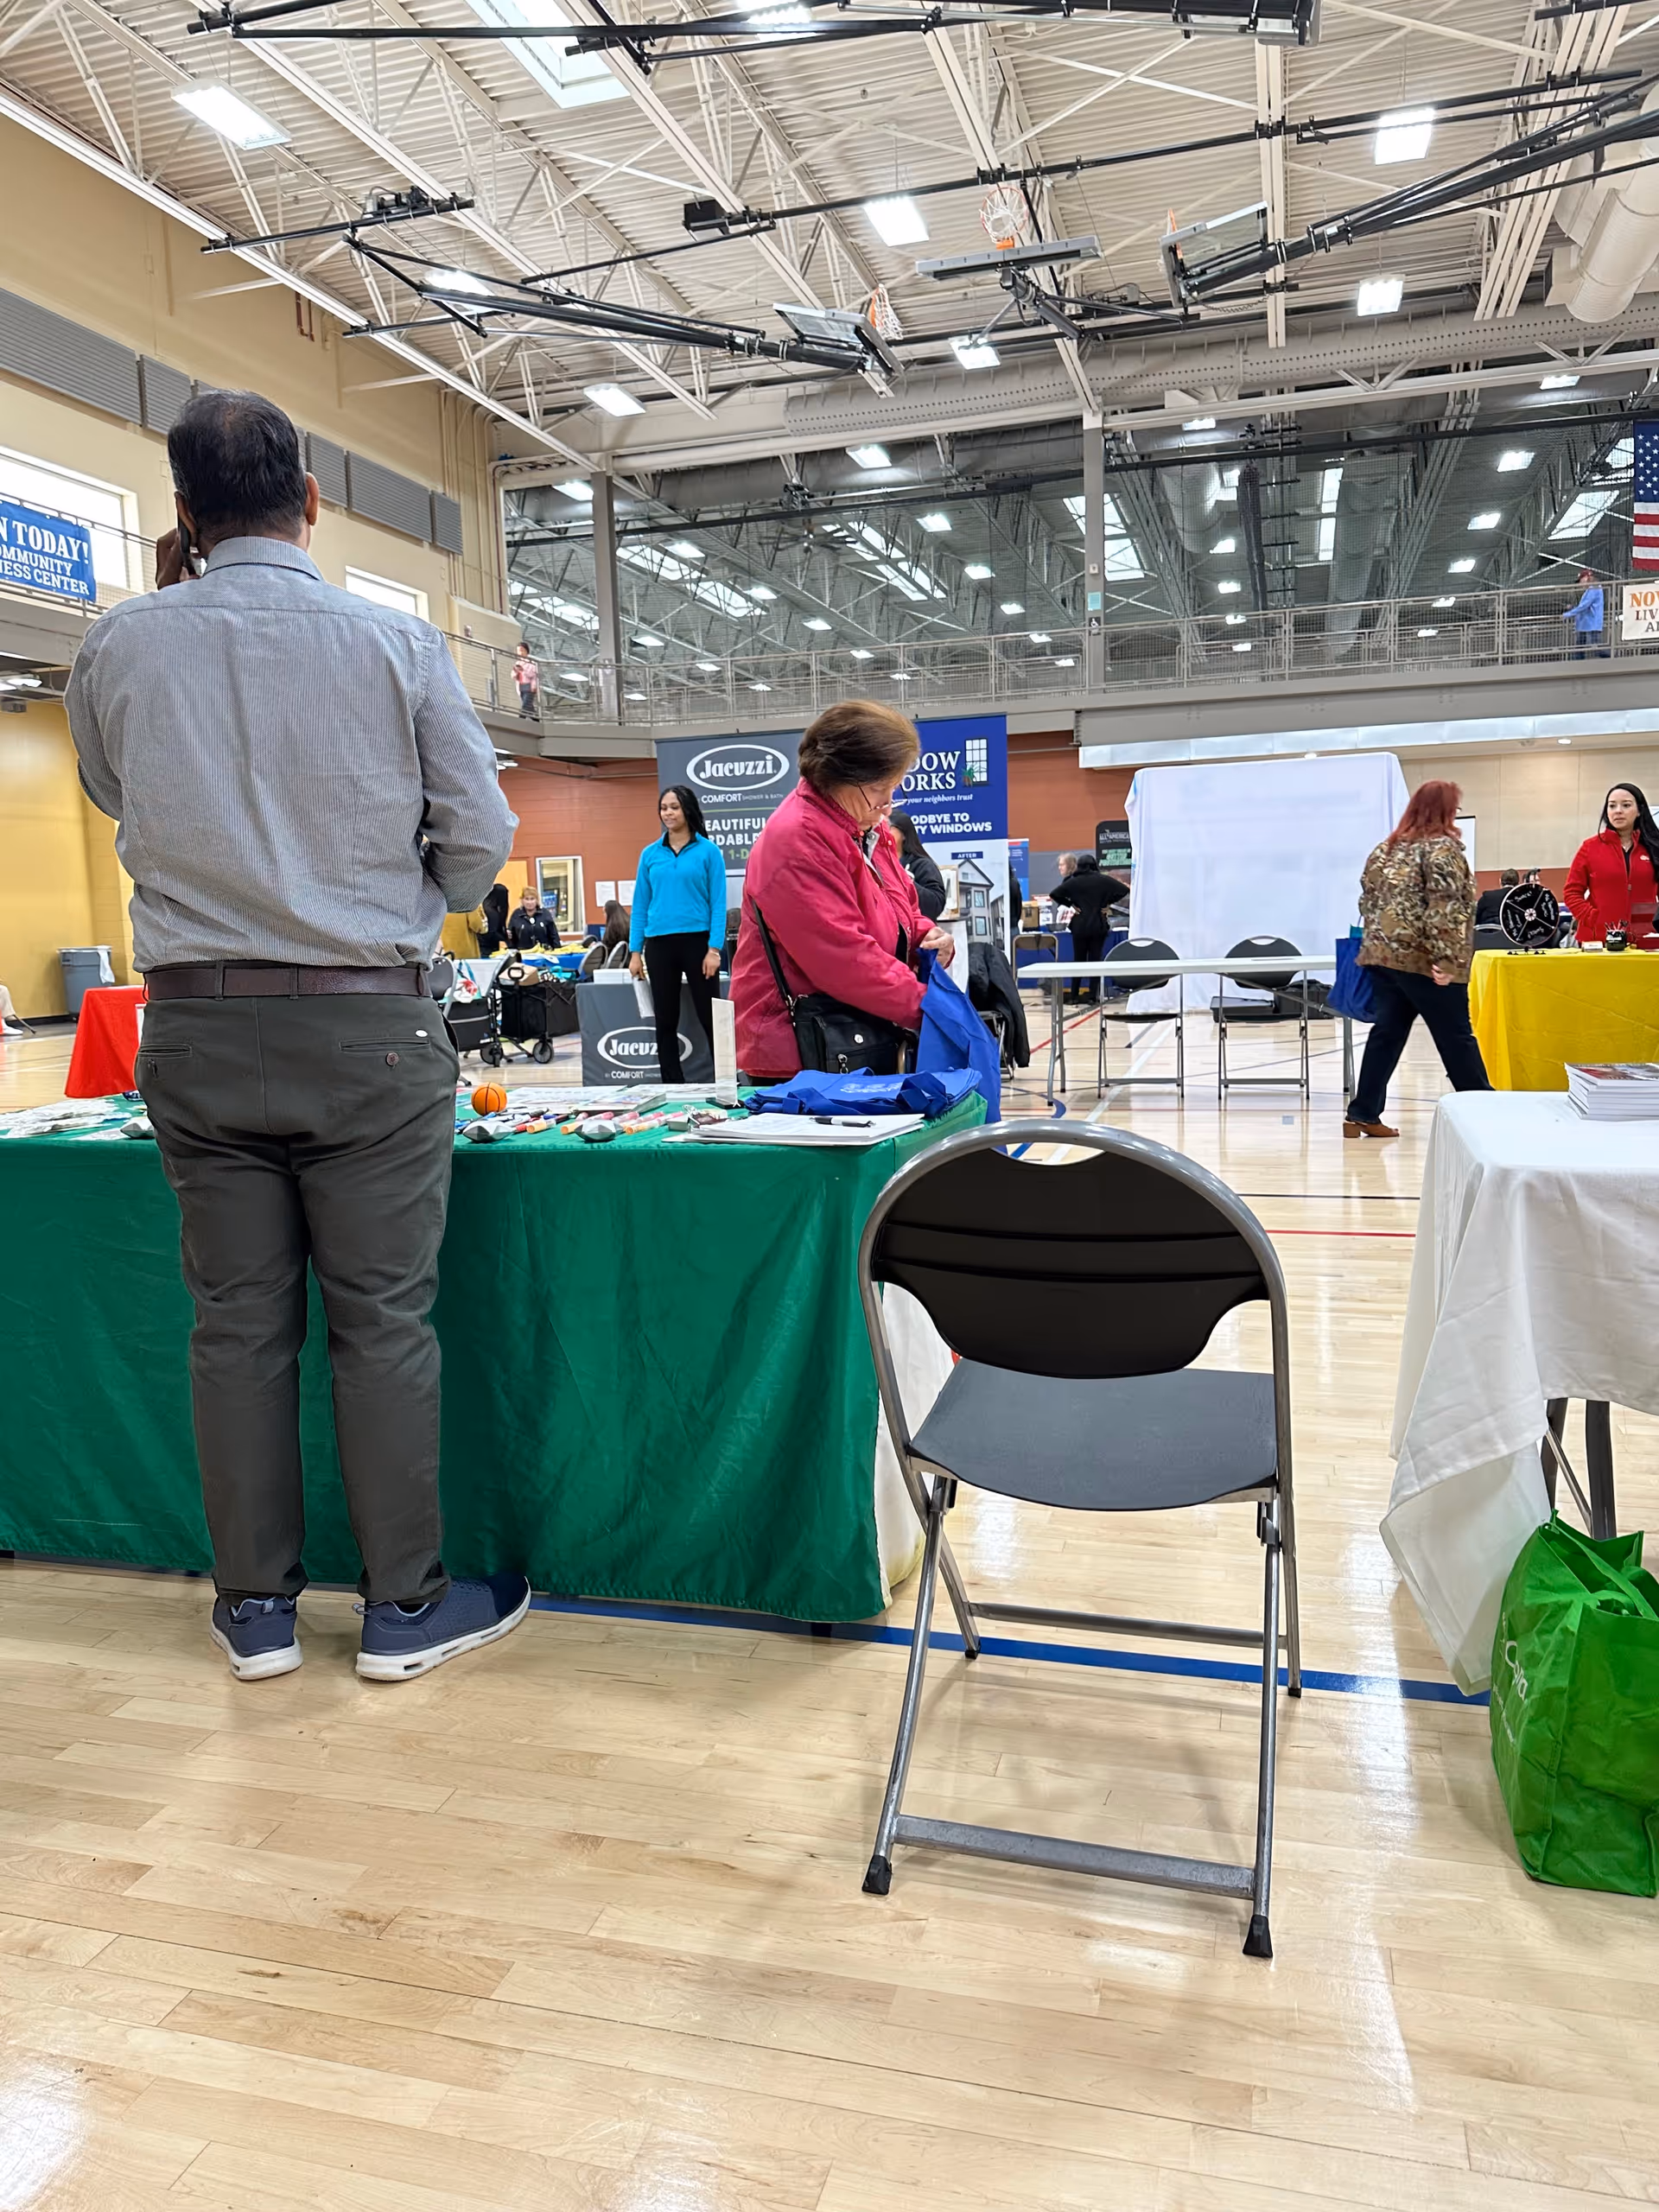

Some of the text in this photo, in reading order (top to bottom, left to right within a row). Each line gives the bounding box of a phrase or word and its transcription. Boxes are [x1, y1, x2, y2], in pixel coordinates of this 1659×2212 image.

[12, 520, 89, 564] TODAY!
[0, 543, 73, 576] MMUNITY
[34, 569, 90, 595] CENTER
[1635, 608, 1659, 620] LIV
[699, 754, 773, 779] Jacuzzi
[907, 751, 961, 772] DOW
[901, 772, 957, 791] ORKS
[701, 793, 742, 803] COMFORT
[907, 796, 922, 805] your
[924, 794, 956, 804] neighbors
[704, 817, 766, 832] EAUTIFUL
[910, 812, 969, 824] ODBYE TO
[929, 822, 992, 835] WINDOWS
[1108, 831, 1130, 840] AMERICA
[708, 833, 760, 845] RDABLE
[609, 1039, 659, 1056] Jacuz
[611, 1071, 645, 1079] COMFORT
